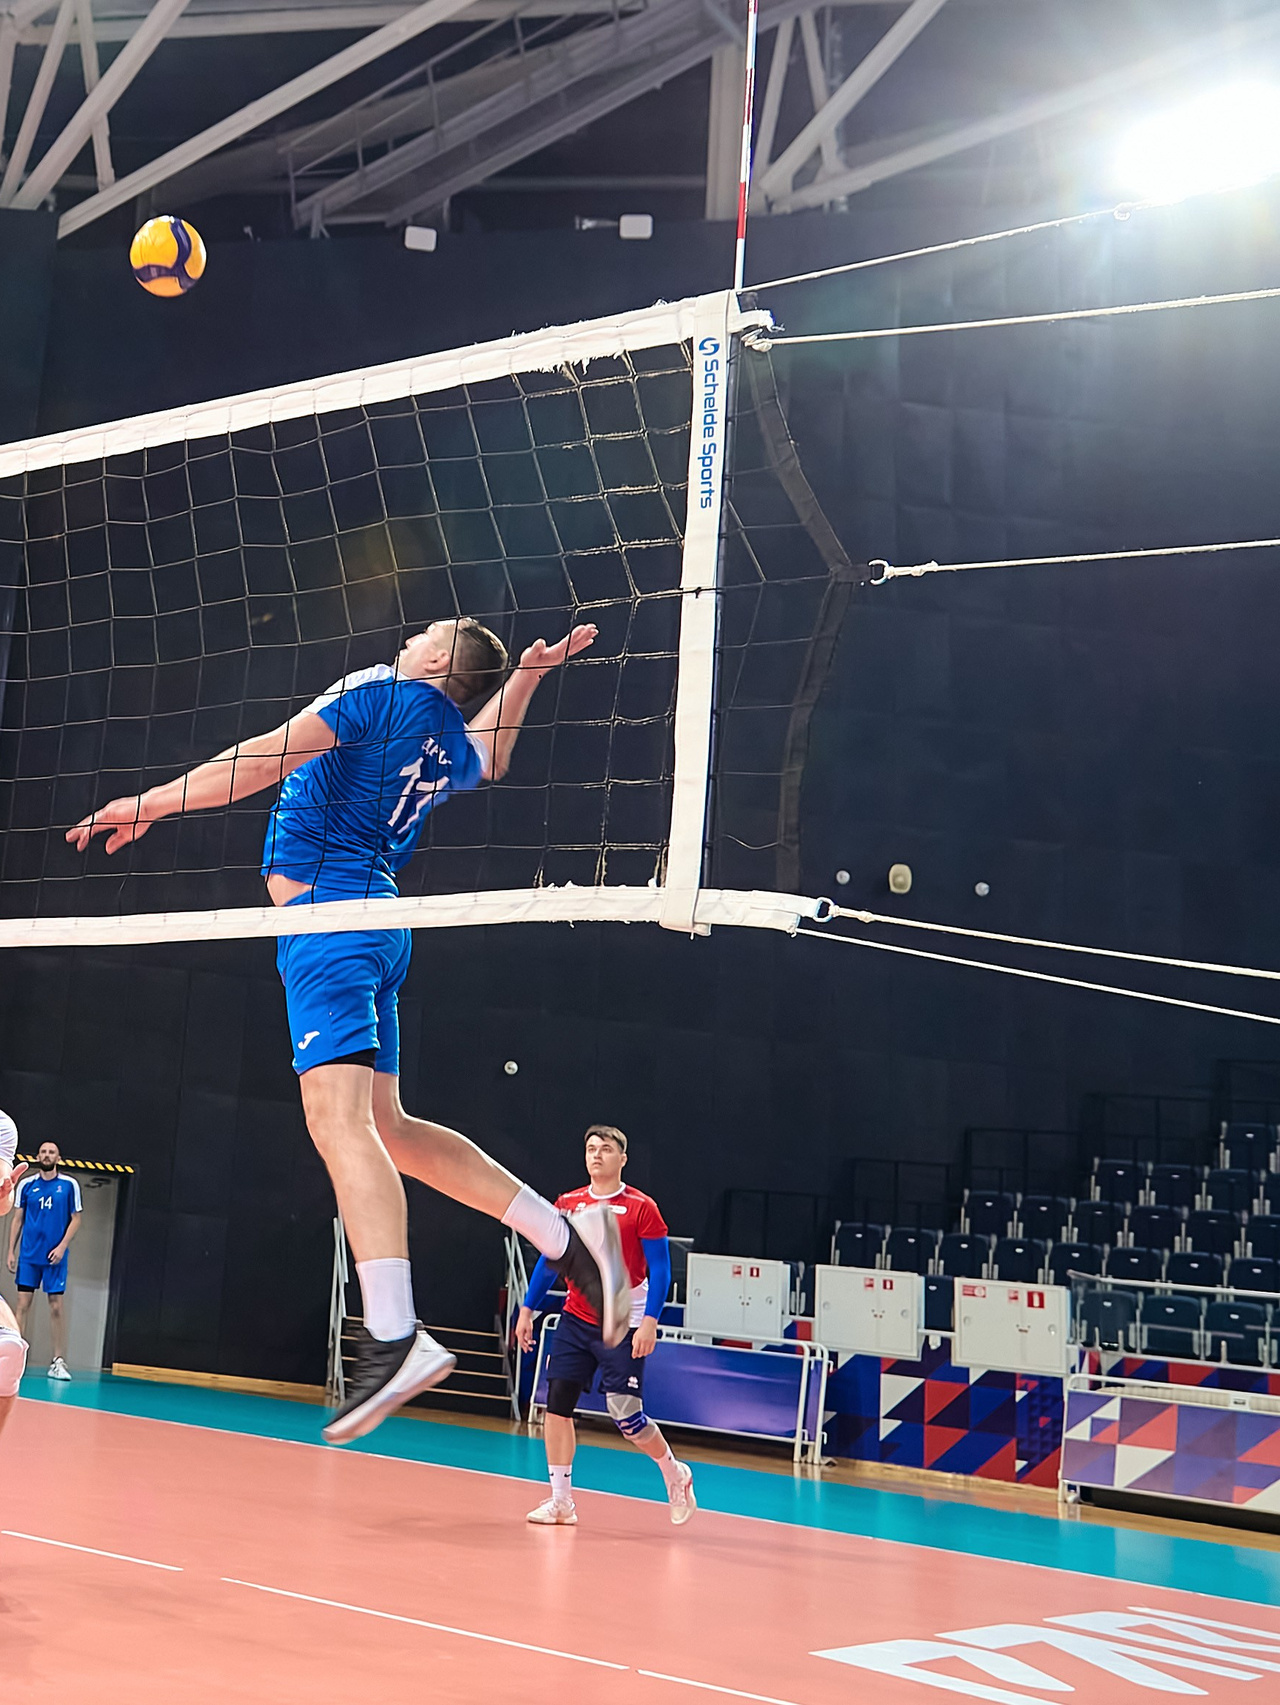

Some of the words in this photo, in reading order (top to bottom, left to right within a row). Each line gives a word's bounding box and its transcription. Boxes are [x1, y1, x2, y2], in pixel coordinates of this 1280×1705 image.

[702, 358, 720, 439] Schelde
[697, 443, 717, 509] Sports
[38, 1196, 52, 1210] 14
